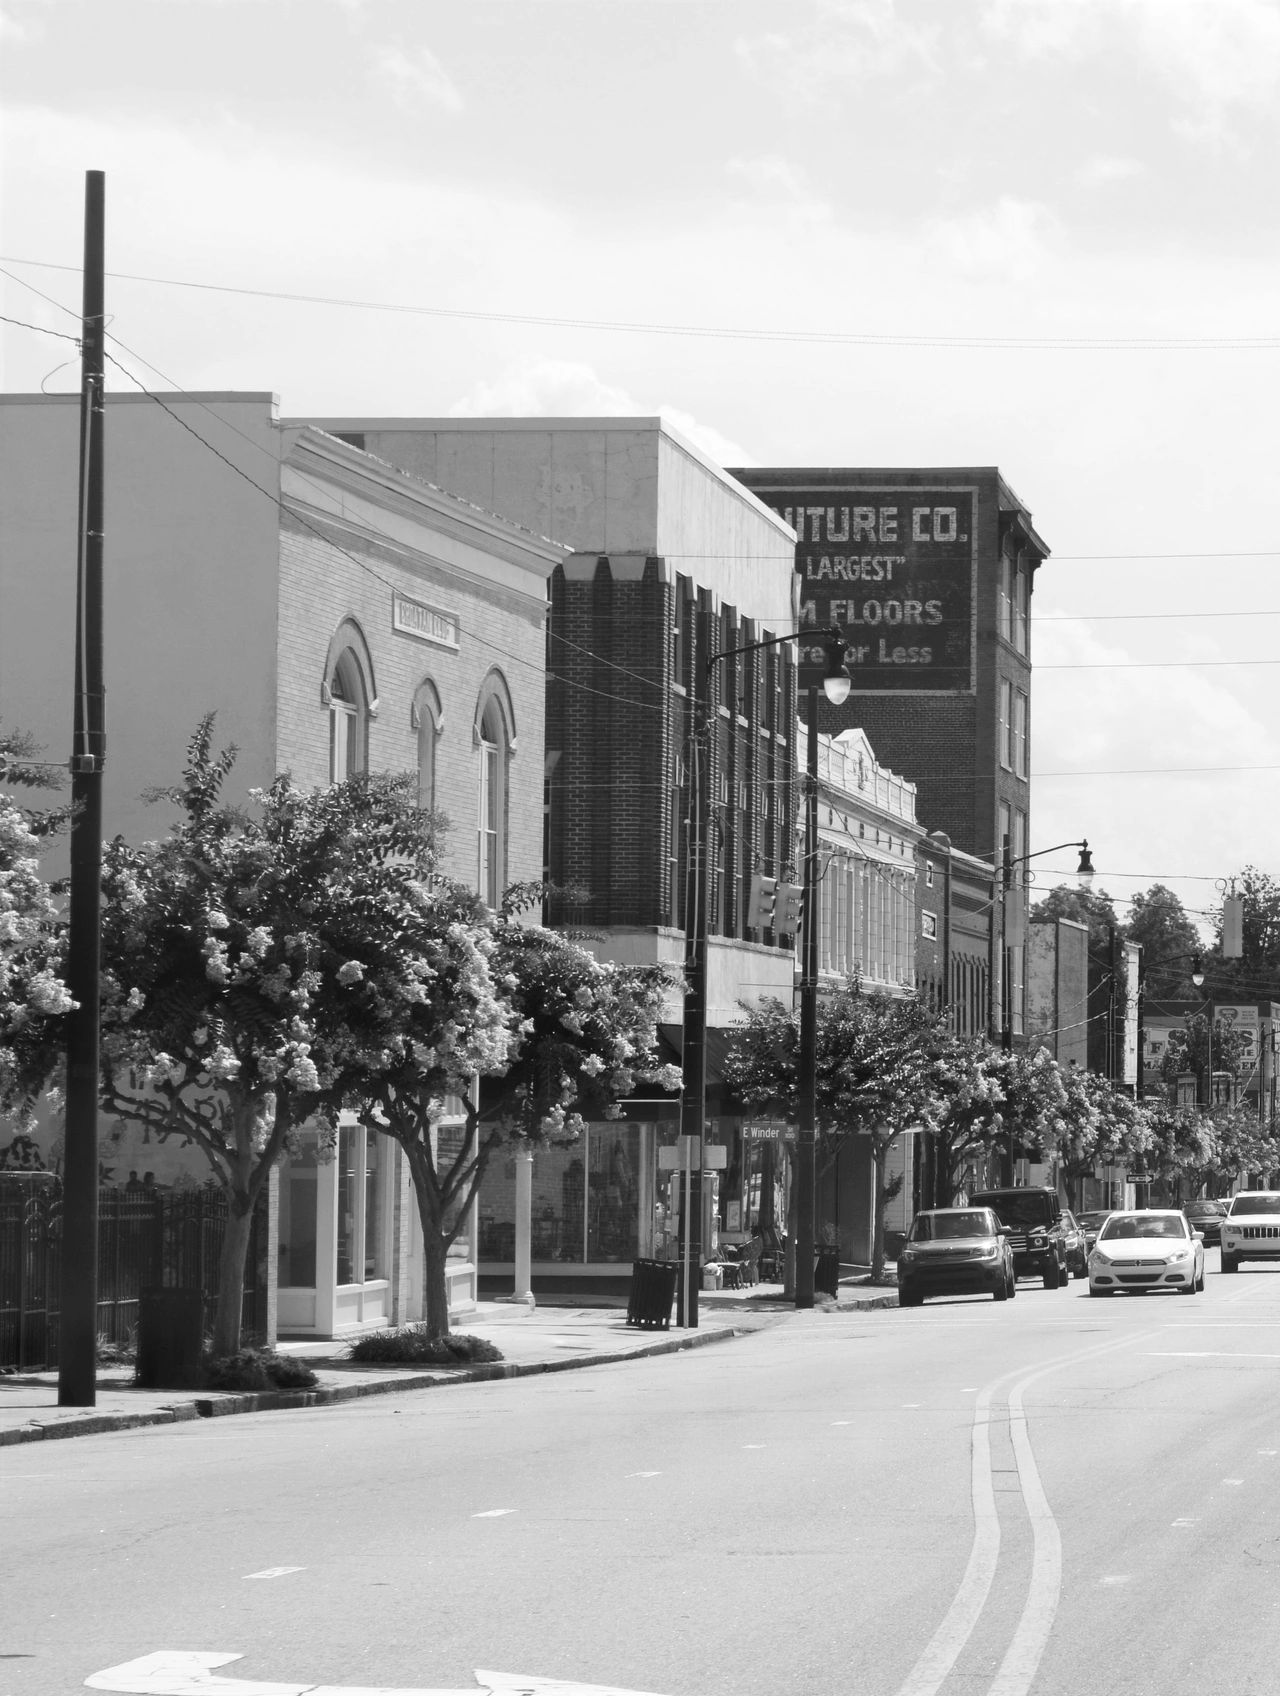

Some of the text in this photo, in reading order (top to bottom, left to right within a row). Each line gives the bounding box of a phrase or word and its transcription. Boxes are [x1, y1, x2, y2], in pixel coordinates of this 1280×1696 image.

[912, 507, 967, 542] CO.
[830, 599, 943, 625] FLOORS
[879, 638, 933, 664] Less
[743, 1127, 780, 1138] E Winder
